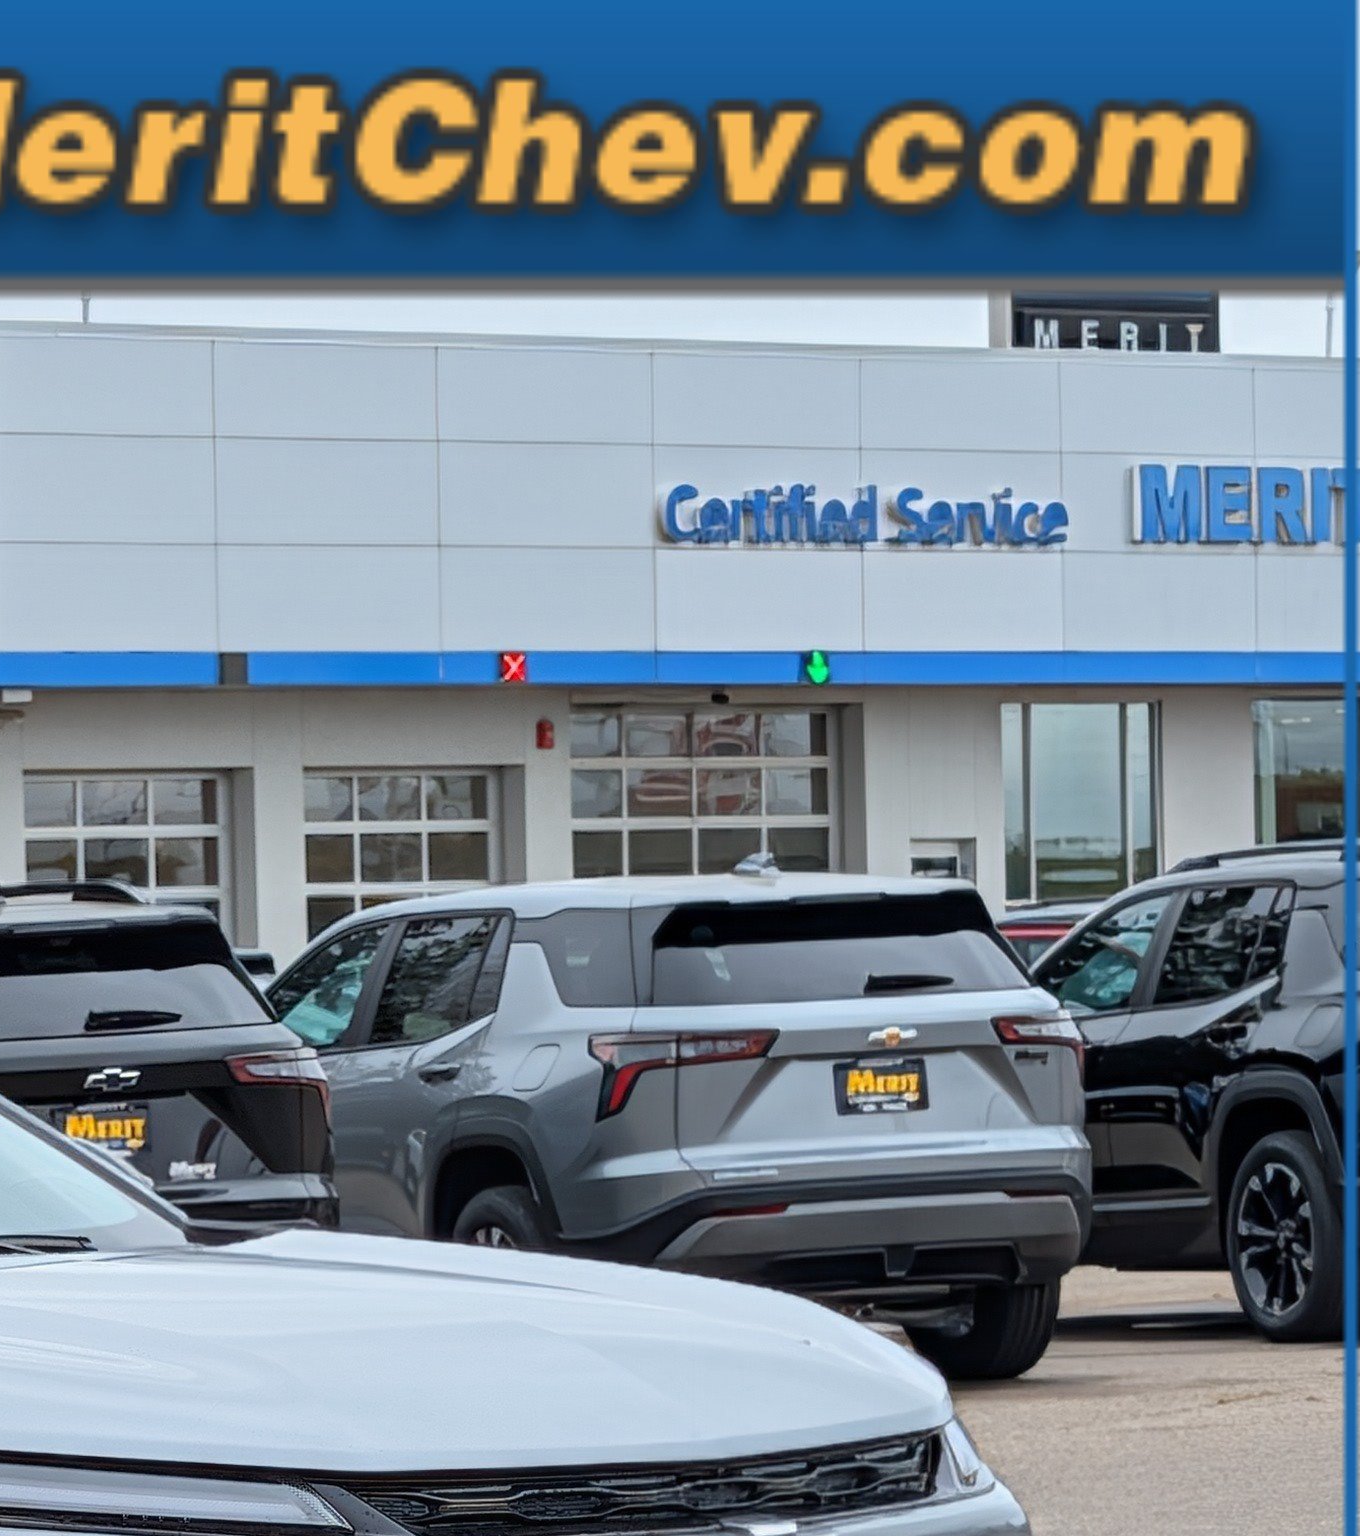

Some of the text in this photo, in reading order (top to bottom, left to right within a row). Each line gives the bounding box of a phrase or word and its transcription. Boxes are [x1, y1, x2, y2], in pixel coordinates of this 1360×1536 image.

[1033, 318, 1204, 352] MERIT
[662, 483, 1069, 546] Certified Service
